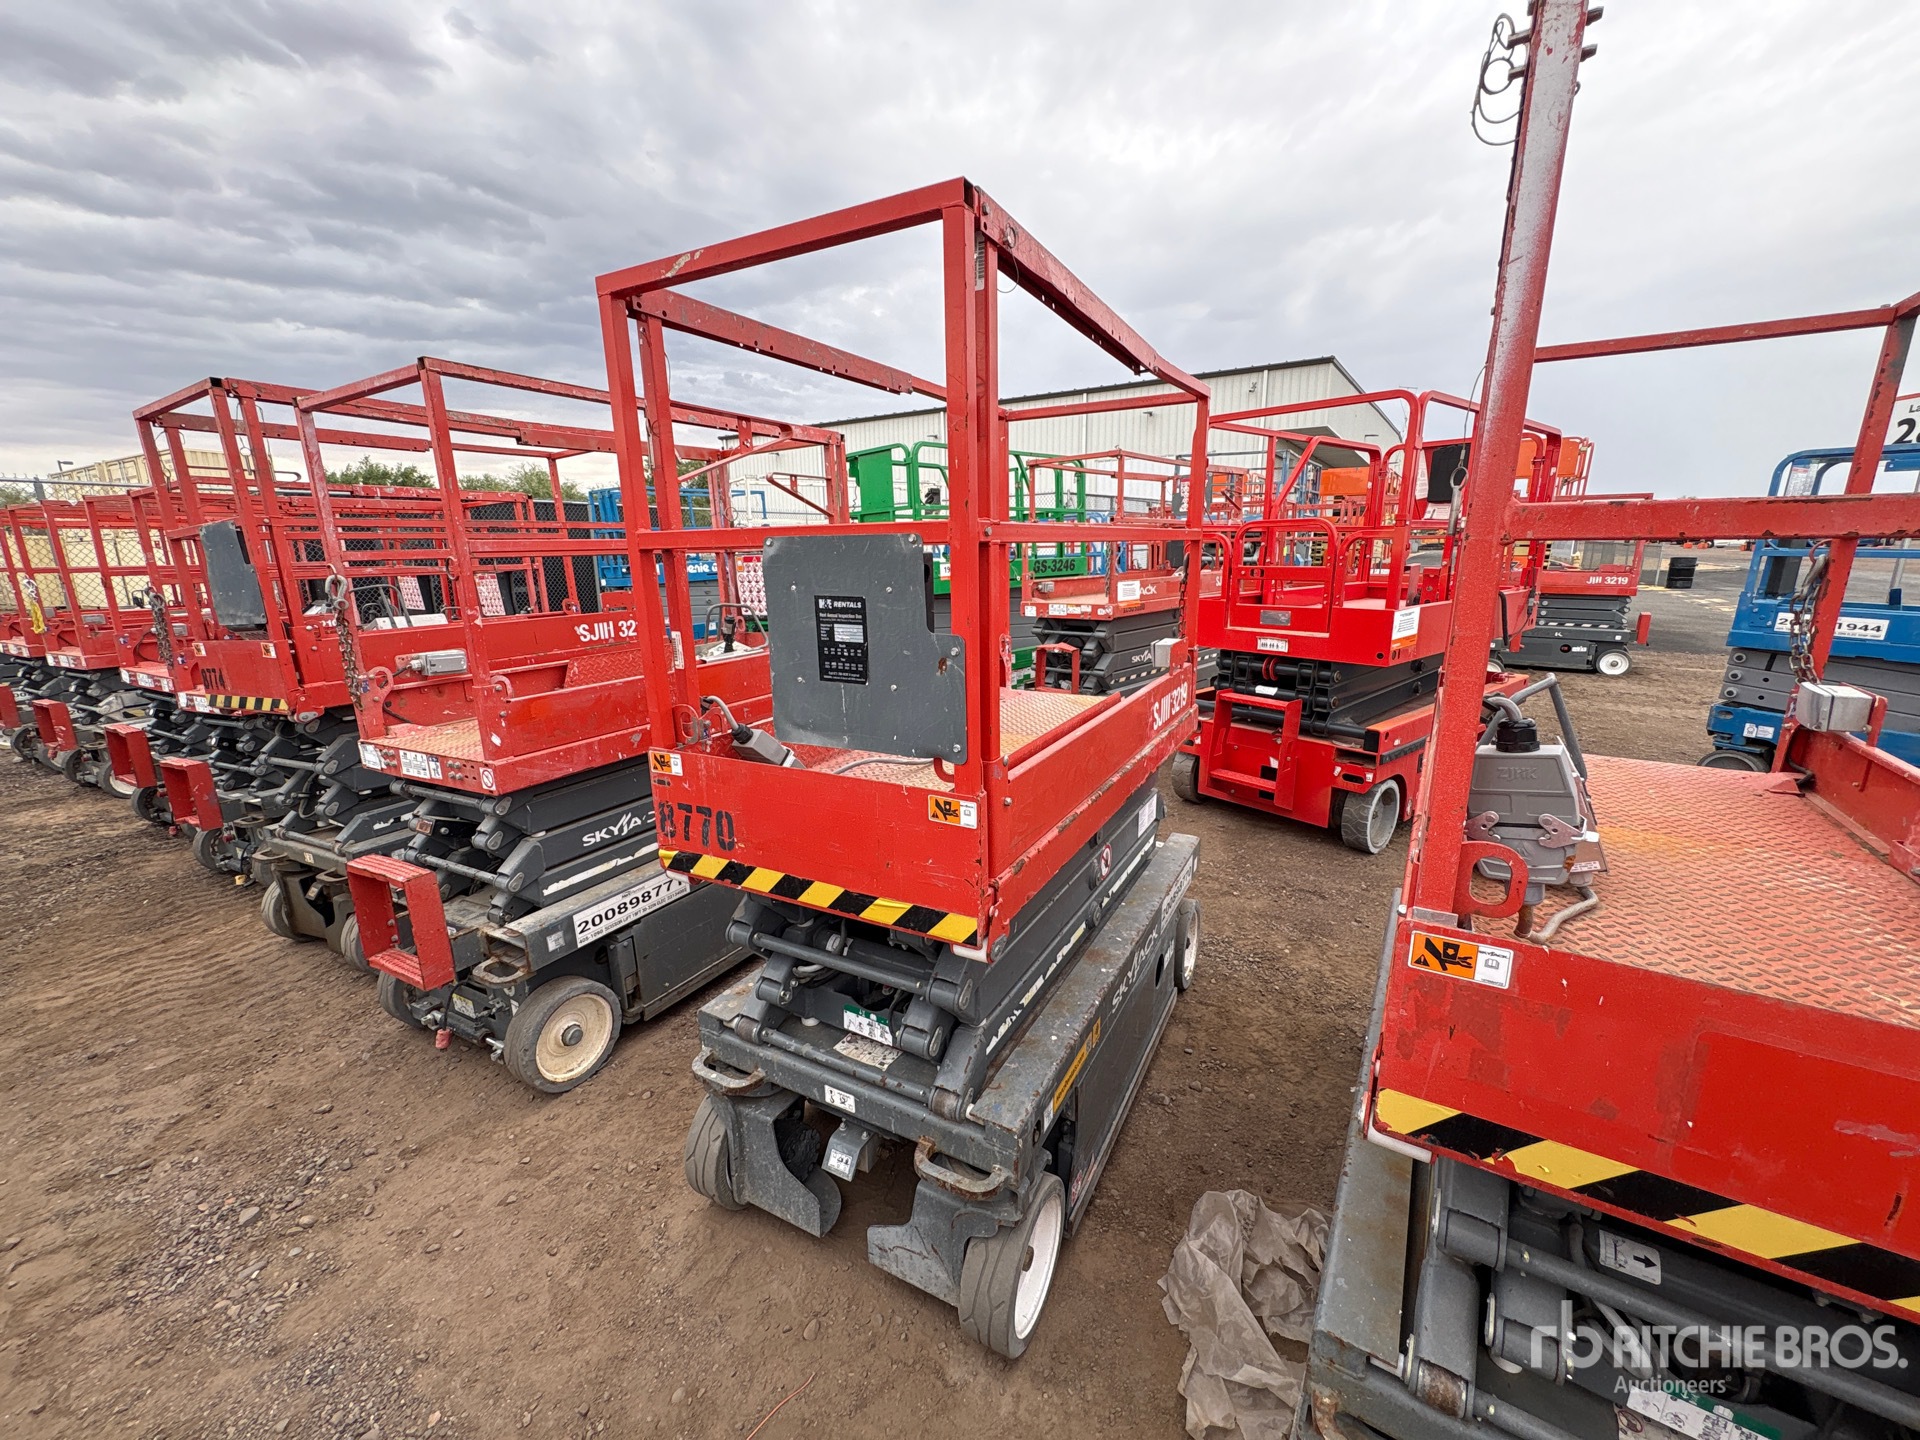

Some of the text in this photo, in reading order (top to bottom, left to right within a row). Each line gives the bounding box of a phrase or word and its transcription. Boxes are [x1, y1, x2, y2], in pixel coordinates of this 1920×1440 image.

[1892, 418, 1920, 445] 2
[686, 563, 710, 573] enie
[1033, 559, 1076, 574] GS-3246
[1604, 576, 1629, 585] 3219
[833, 601, 862, 609] RENTALS
[618, 619, 638, 638] 32
[1131, 649, 1152, 664] SKYJA
[658, 800, 735, 852] 8770
